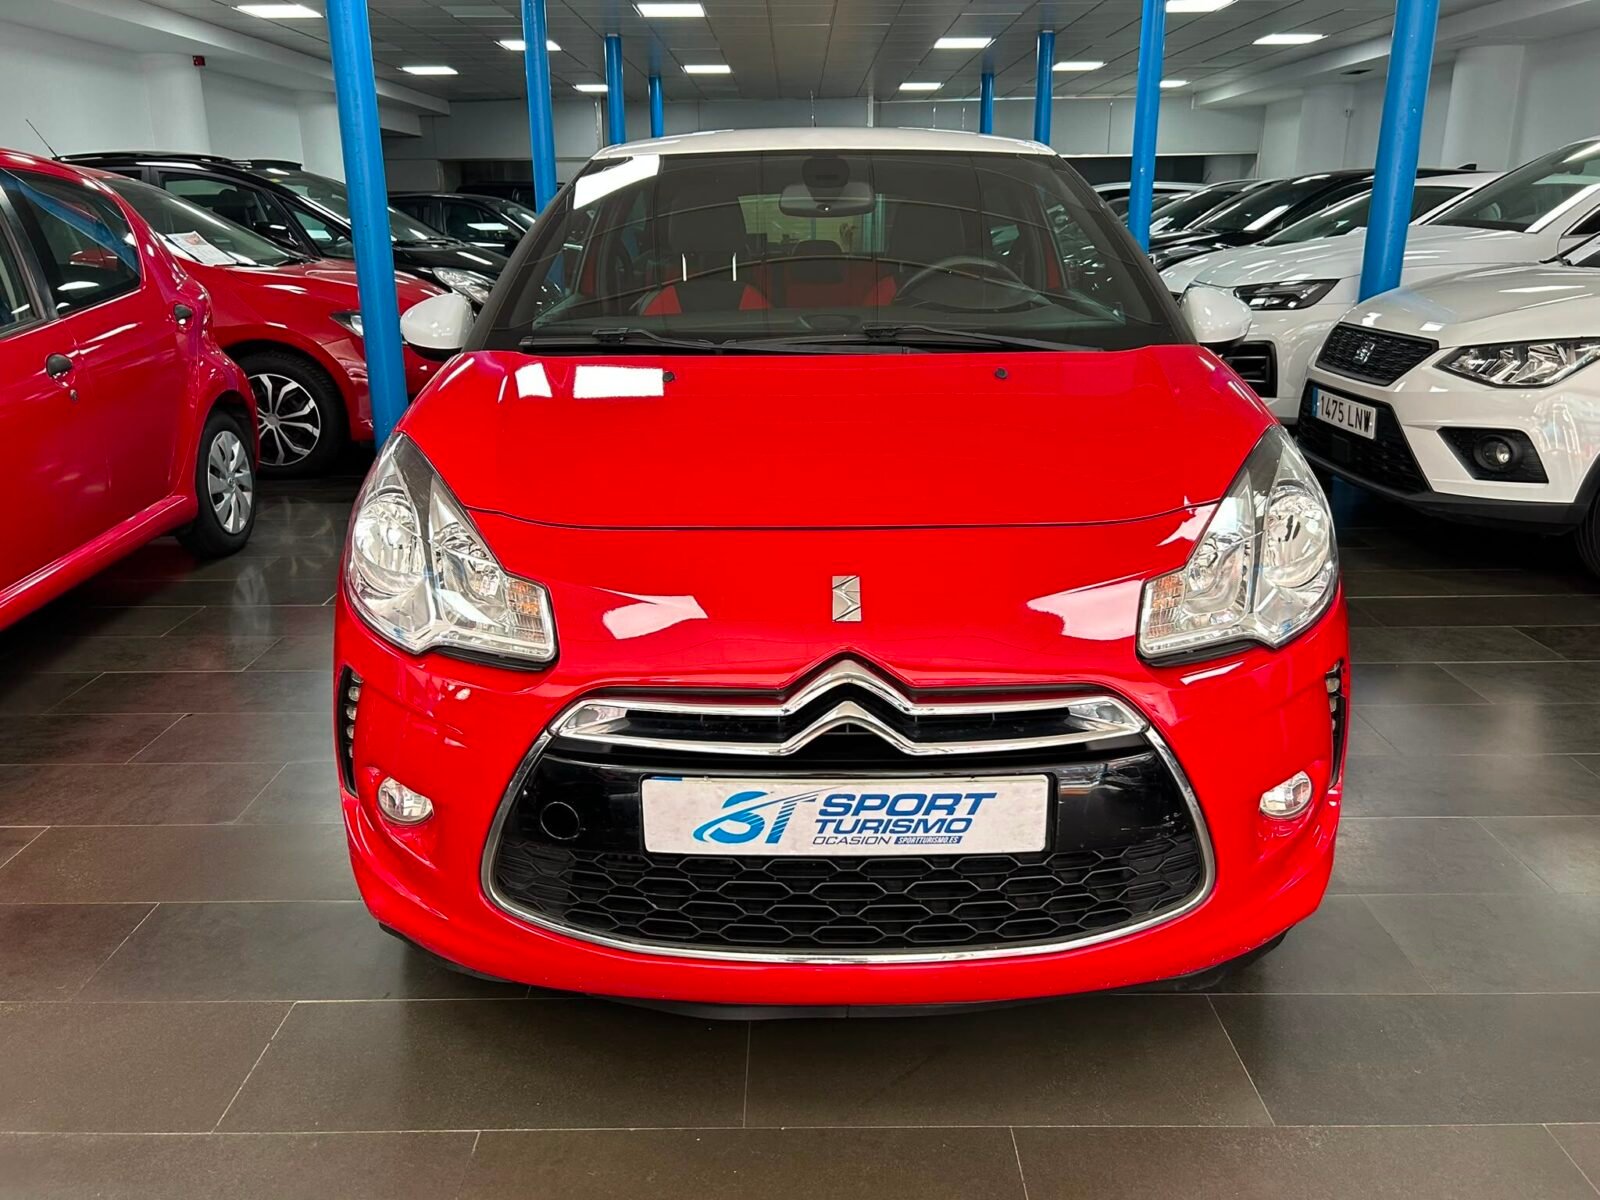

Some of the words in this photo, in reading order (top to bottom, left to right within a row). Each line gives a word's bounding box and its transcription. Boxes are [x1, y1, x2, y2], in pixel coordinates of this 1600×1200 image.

[1321, 395, 1344, 423] 1475
[1347, 405, 1371, 433] LNW
[818, 792, 997, 817] SPORT
[815, 817, 973, 834] TURISMO
[812, 836, 892, 845] OCASION
